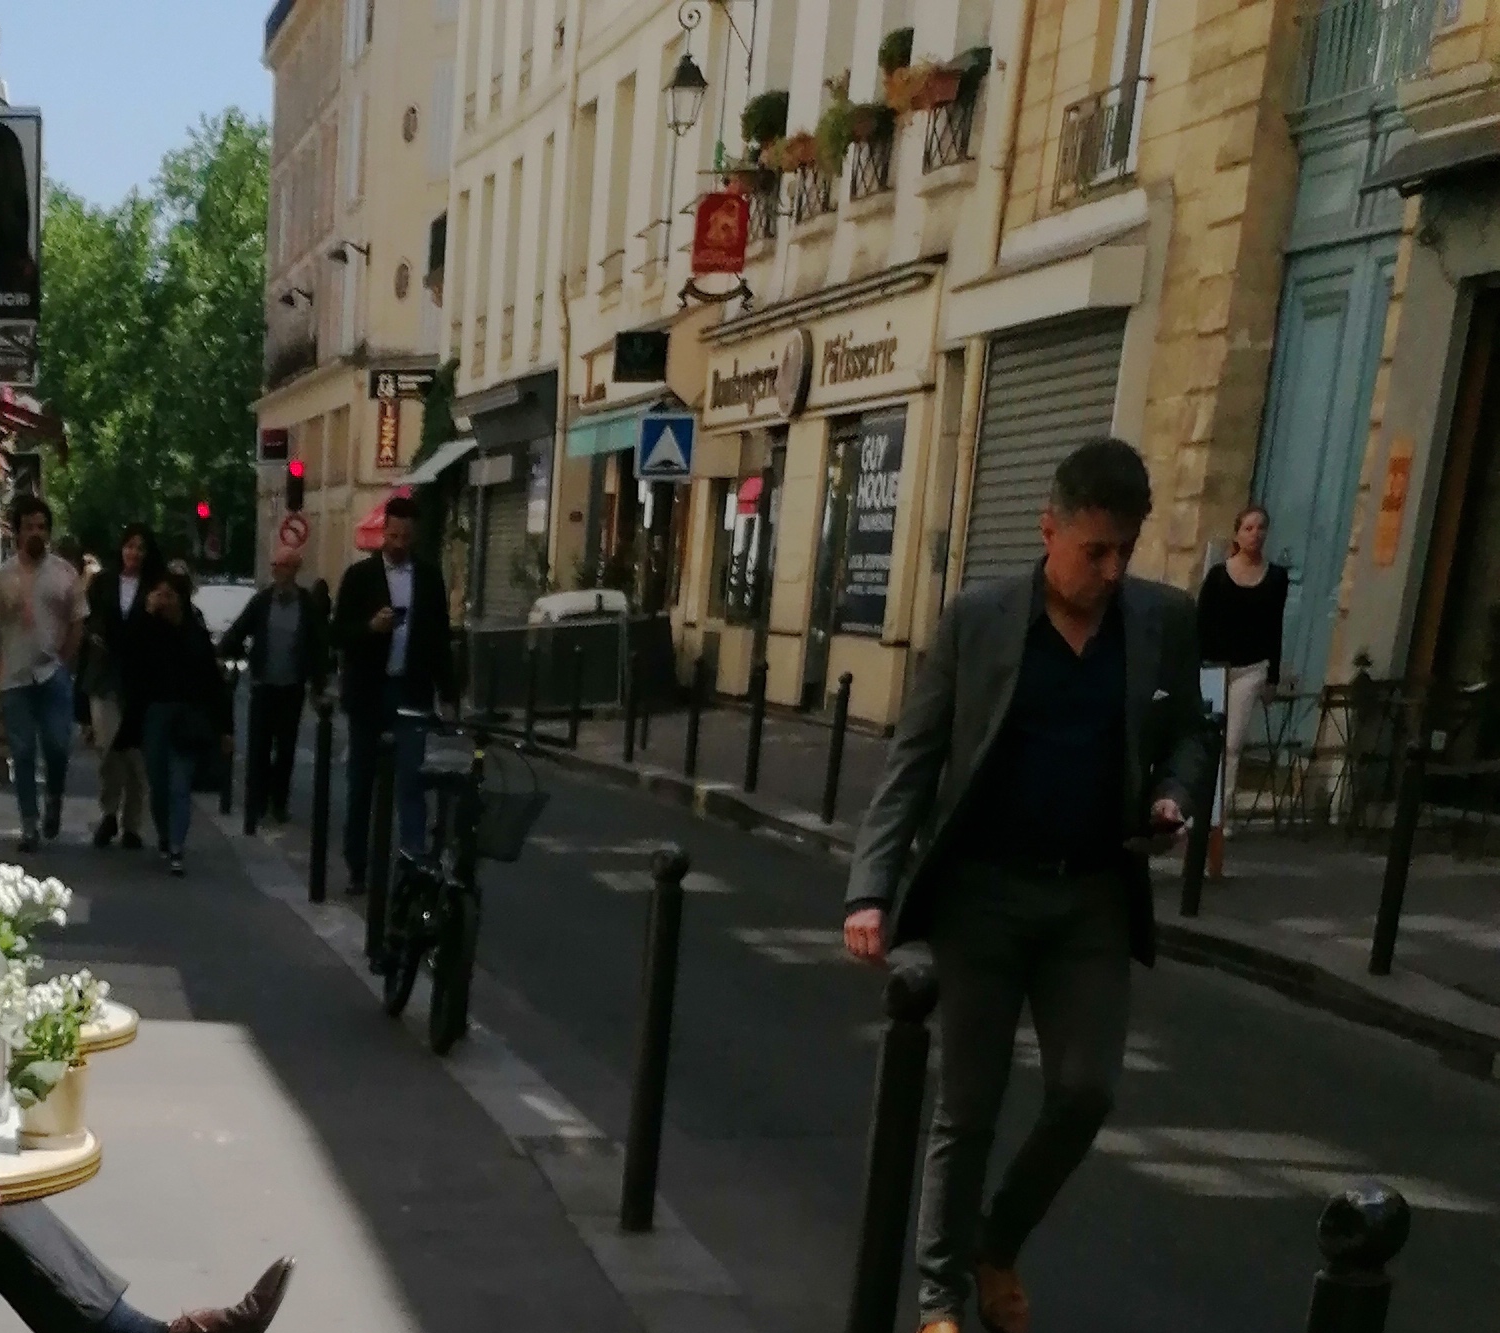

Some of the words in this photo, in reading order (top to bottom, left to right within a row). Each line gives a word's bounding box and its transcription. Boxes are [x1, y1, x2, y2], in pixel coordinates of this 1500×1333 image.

[710, 350, 779, 415] Boulangeri
[380, 399, 396, 458] IZZA
[861, 434, 889, 472] GUY
[856, 471, 898, 511] MOQUE
